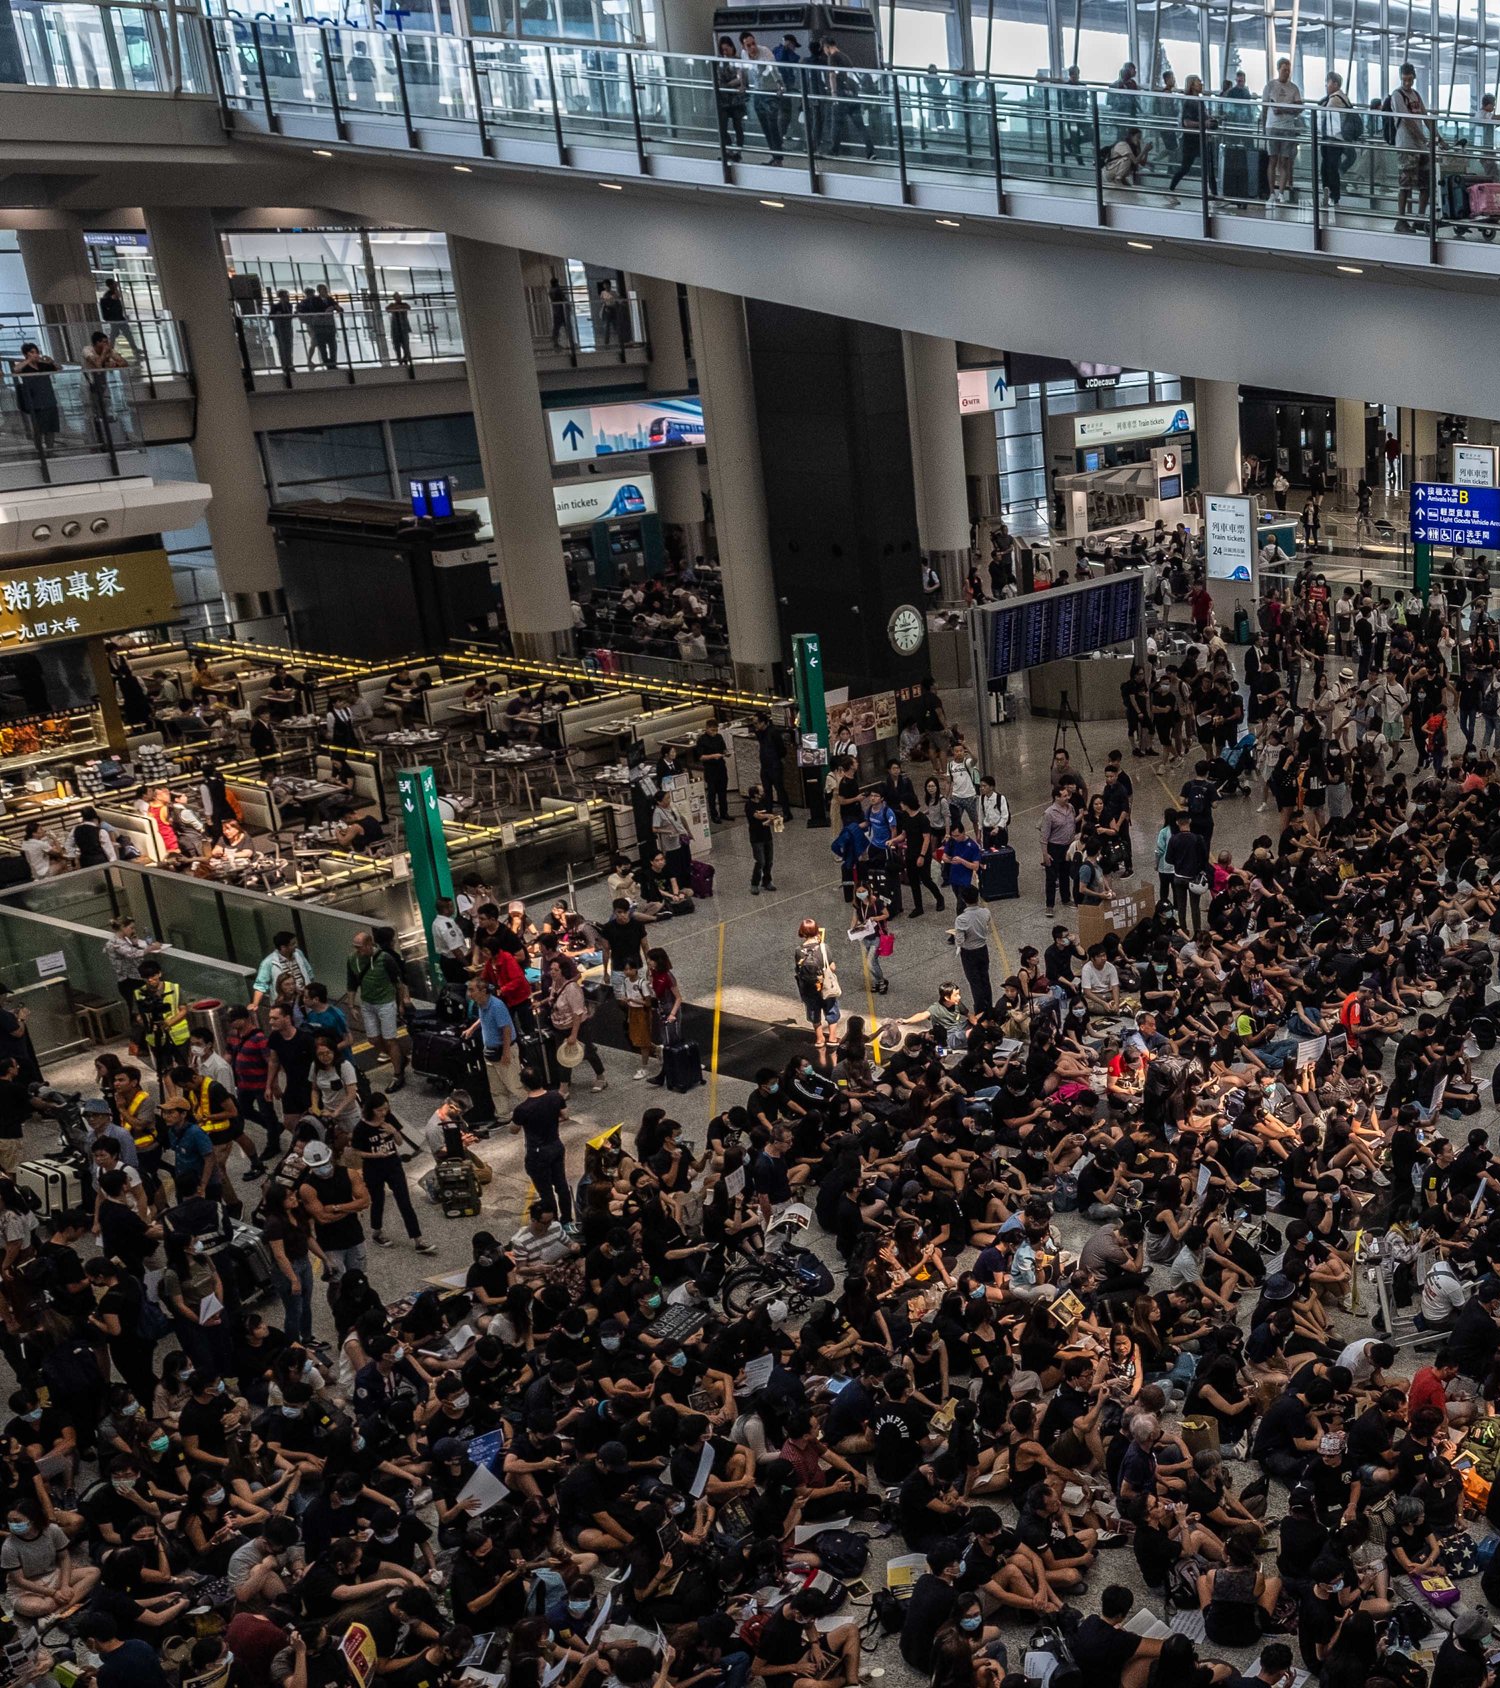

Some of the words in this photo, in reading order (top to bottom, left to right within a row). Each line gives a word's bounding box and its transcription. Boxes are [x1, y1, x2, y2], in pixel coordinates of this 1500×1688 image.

[1085, 378, 1117, 388] JCDecaux
[1138, 419, 1150, 427] Train
[1472, 478, 1489, 486] tickets
[1427, 495, 1447, 503] Arrivals
[1459, 490, 1469, 504] B
[557, 501, 569, 511] ain
[571, 498, 598, 509] tickets
[1440, 516, 1453, 524] Light
[1453, 517, 1471, 525] Goods
[1471, 518, 1489, 526] Vehicle
[1226, 534, 1246, 543] tickets
[1466, 537, 1483, 545] Toilets
[1212, 546, 1222, 555] 24
[0, 567, 126, 612] 粥麵專家
[0, 616, 81, 643] 一九四六年
[875, 1414, 910, 1439] CHAMPION
